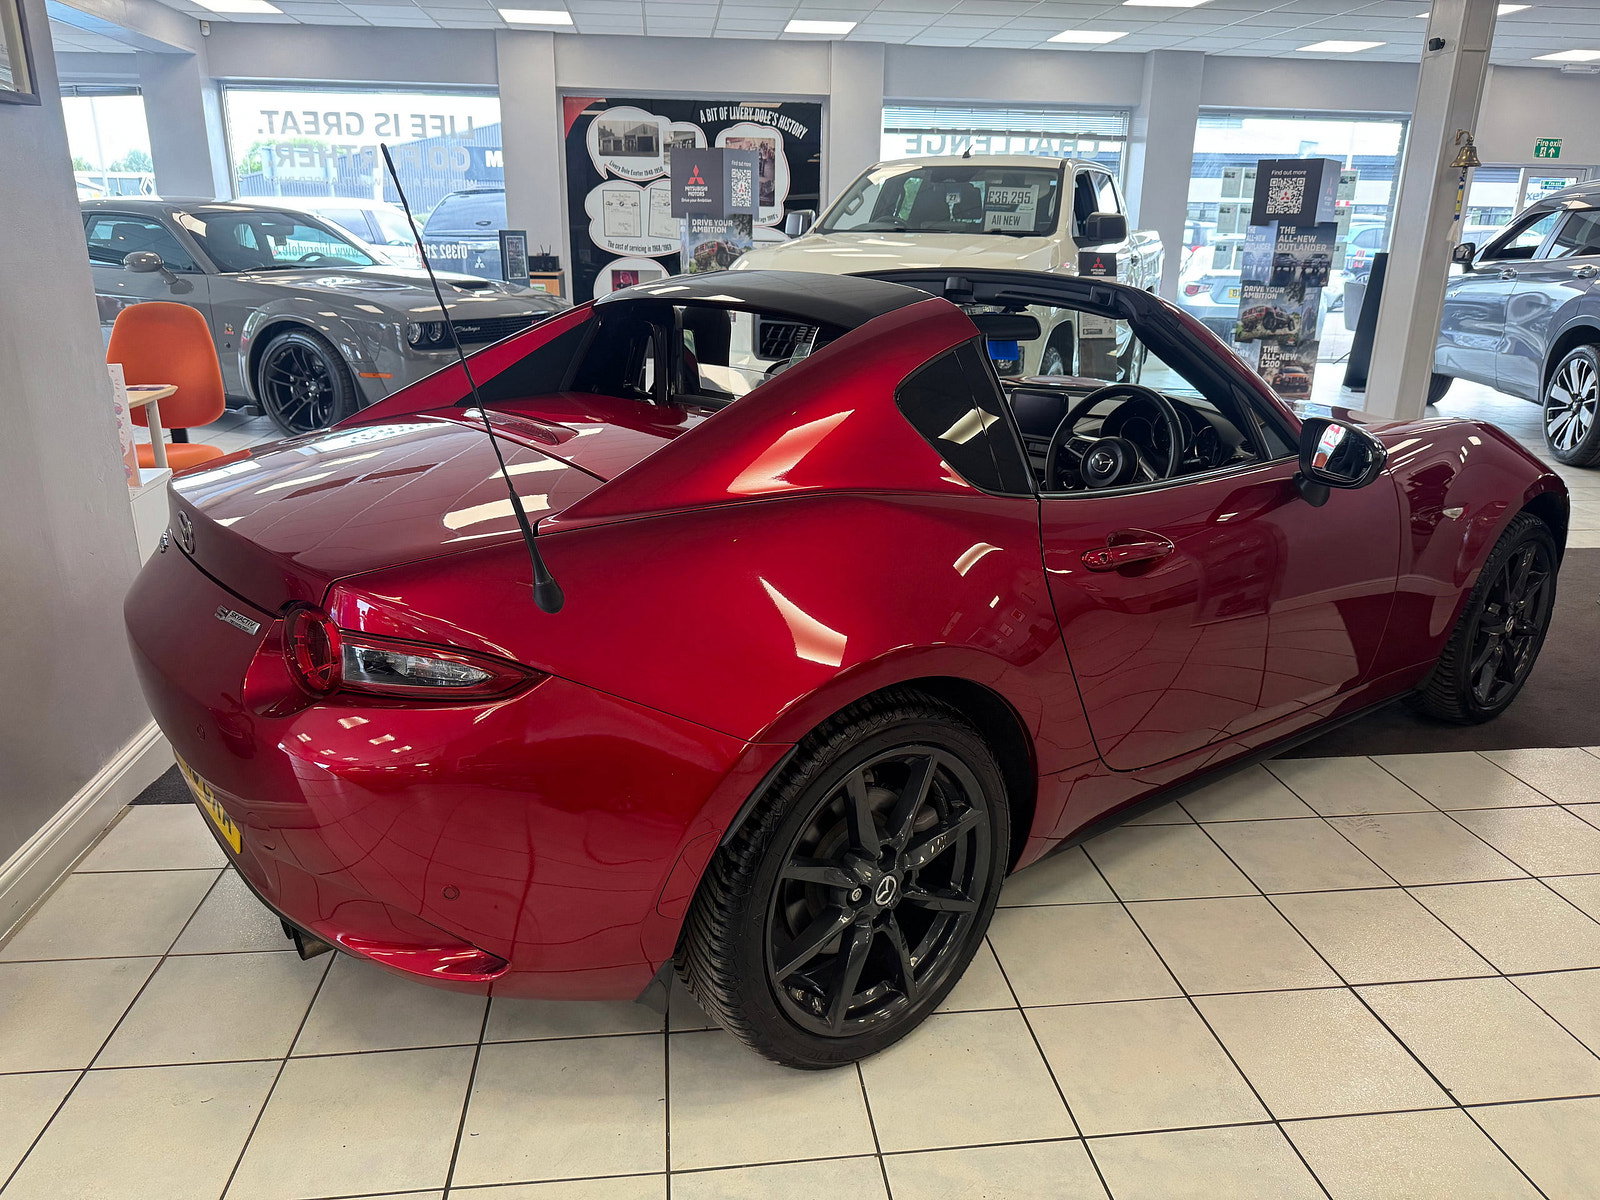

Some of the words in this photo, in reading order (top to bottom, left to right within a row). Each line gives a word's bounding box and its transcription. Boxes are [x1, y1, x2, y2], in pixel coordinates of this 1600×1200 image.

[699, 109, 707, 124] A
[705, 107, 718, 123] BIT
[719, 106, 728, 121] OF
[729, 106, 754, 121] LIVERY
[754, 107, 779, 127] DOLE'S
[778, 114, 809, 140] HISTORY
[713, 219, 734, 227] YOUR
[1003, 215, 1021, 226] NEW
[691, 226, 727, 234] AMBITION
[1279, 226, 1296, 234] THE
[1278, 235, 1318, 243] ALL-NEW
[1277, 243, 1328, 252] OUTLANDER
[1260, 360, 1280, 368] L200
